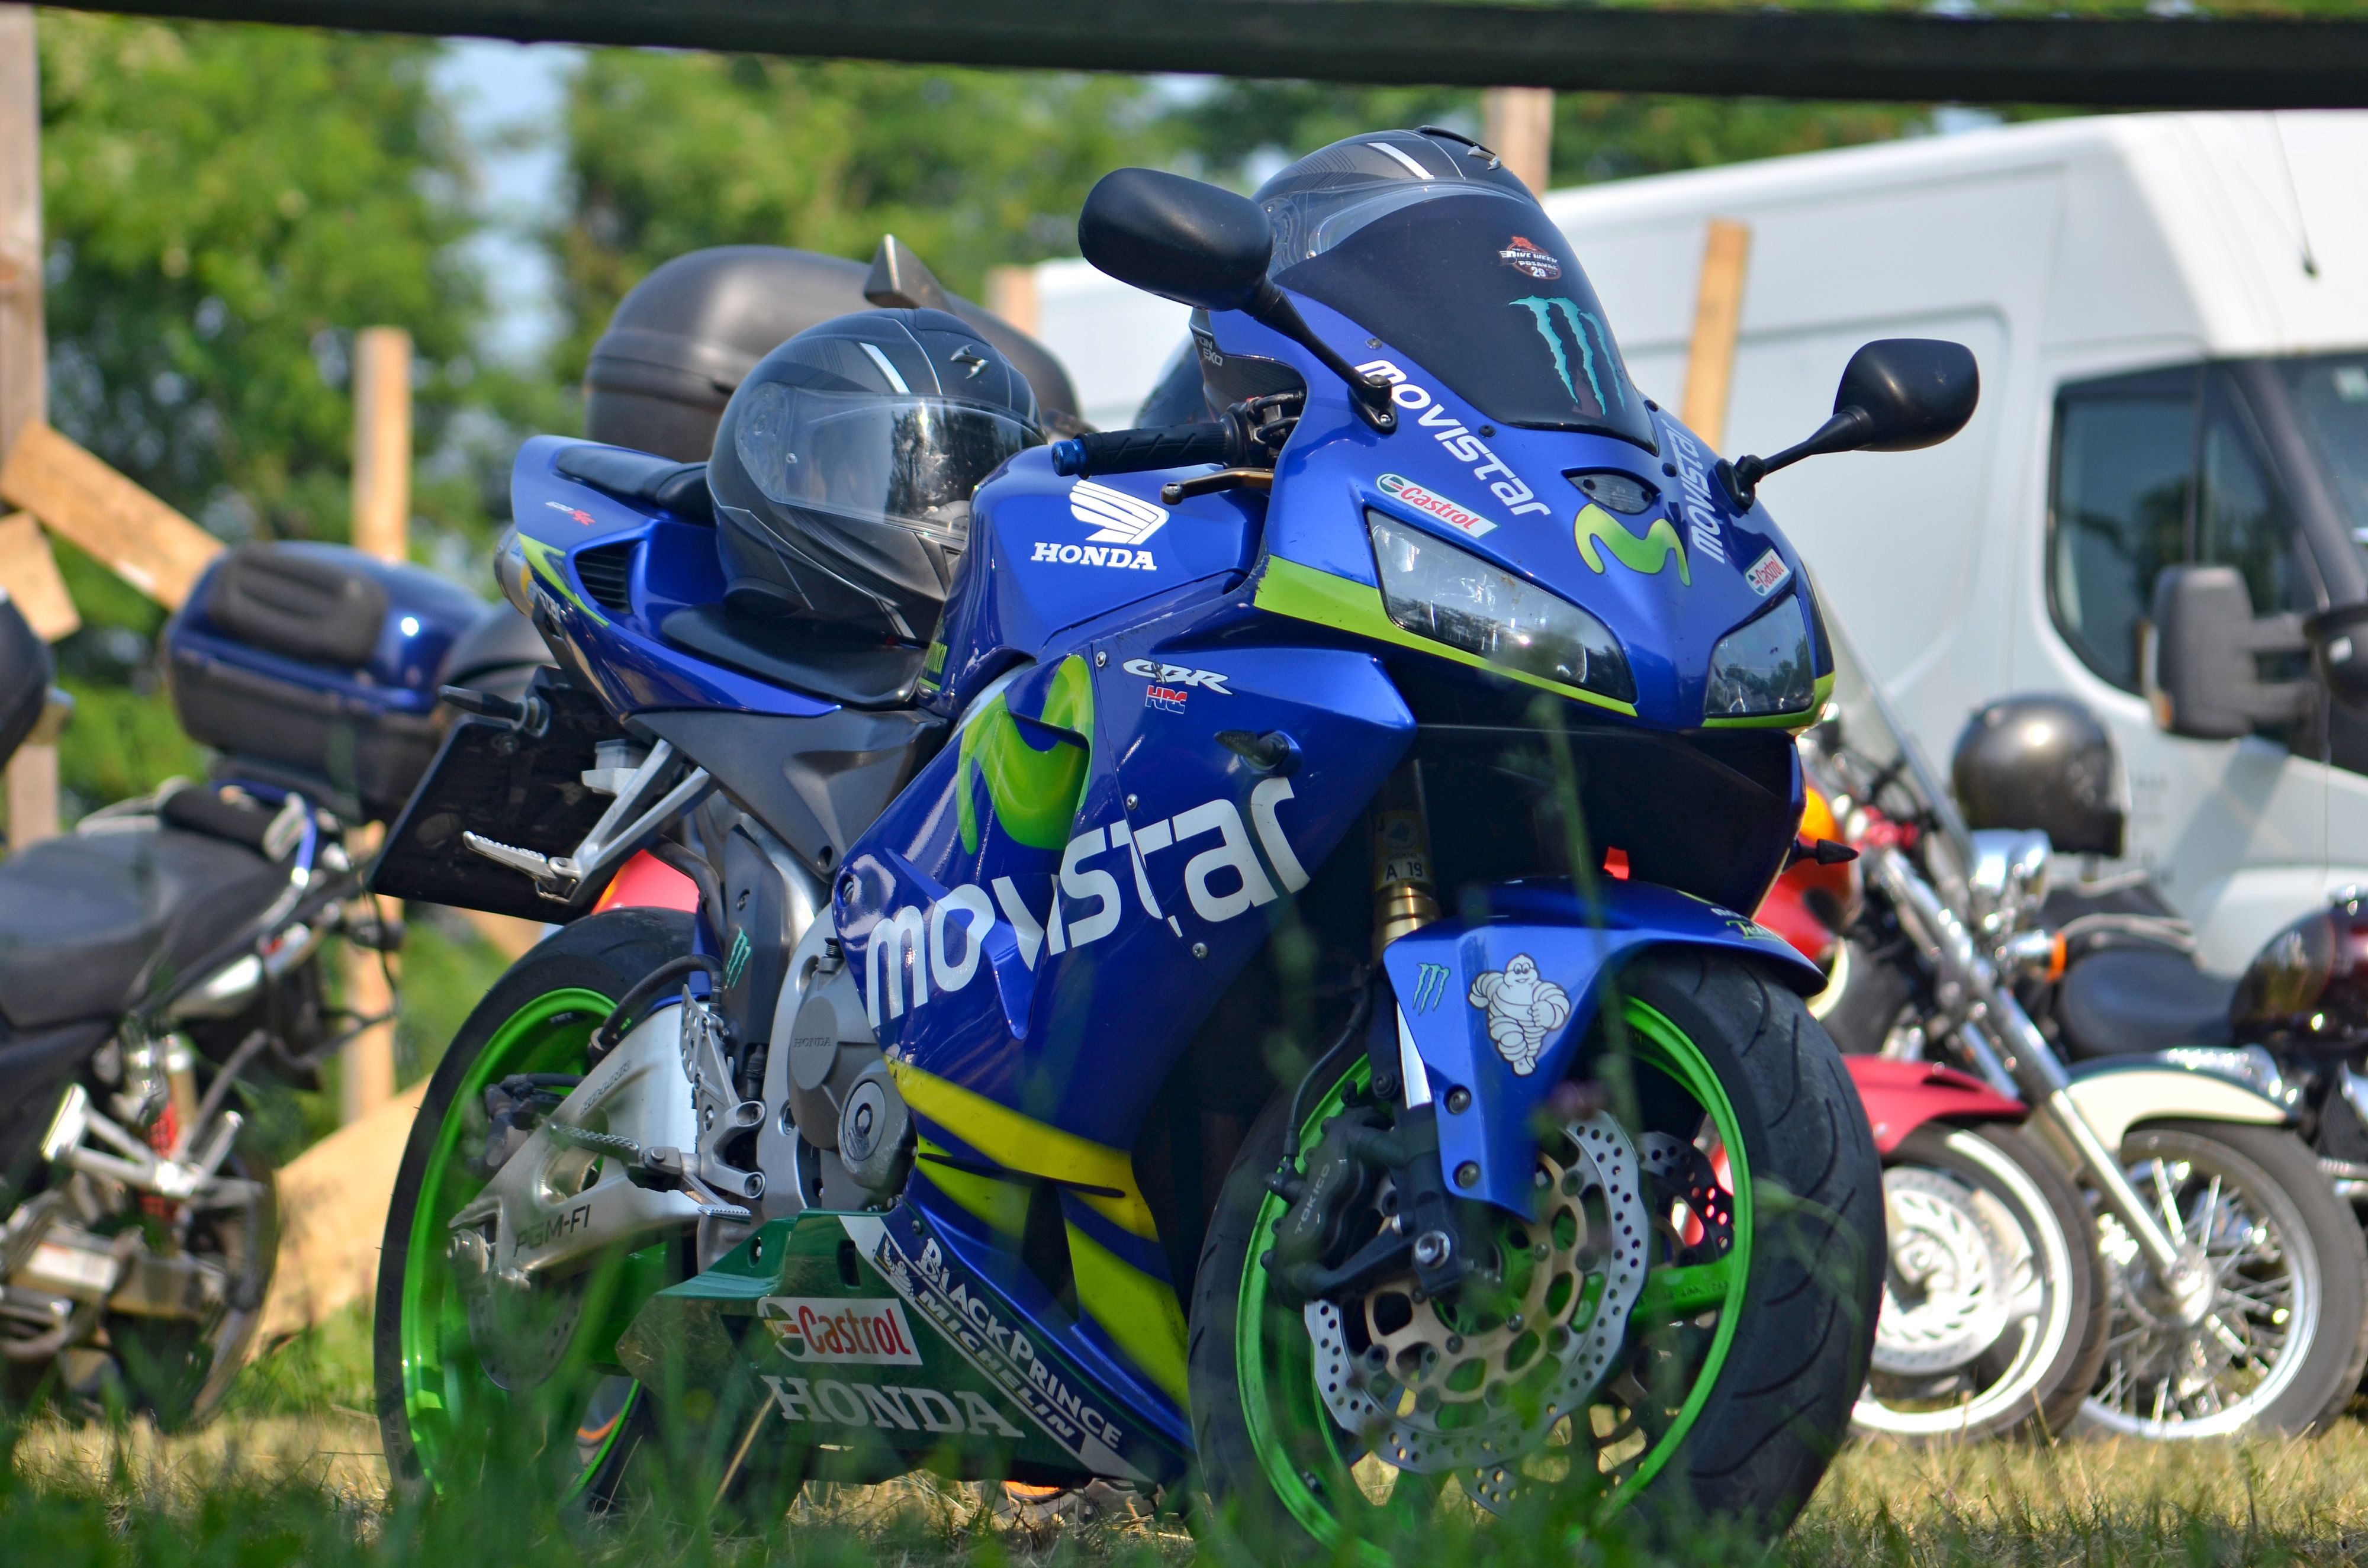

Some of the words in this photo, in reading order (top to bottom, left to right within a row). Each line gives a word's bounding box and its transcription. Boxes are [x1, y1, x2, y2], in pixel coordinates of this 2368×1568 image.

[1203, 348, 1223, 366] EXO
[1401, 485, 1480, 530] Castrol
[1031, 542, 1157, 571] HONDA
[1755, 555, 1784, 589] Castrol
[1123, 658, 1235, 695] CBR
[1145, 685, 1188, 714] HRC
[794, 1036, 831, 1048] HONDA
[1295, 1163, 1330, 1235] TOKICO
[513, 1203, 591, 1258] PGM-FI
[798, 1305, 912, 1356] Castrol
[915, 1237, 1011, 1352] BLACK
[1009, 1330, 1122, 1449] PRINCE
[919, 1290, 1076, 1438] MICHELIN
[760, 1375, 1025, 1438] HONDA
